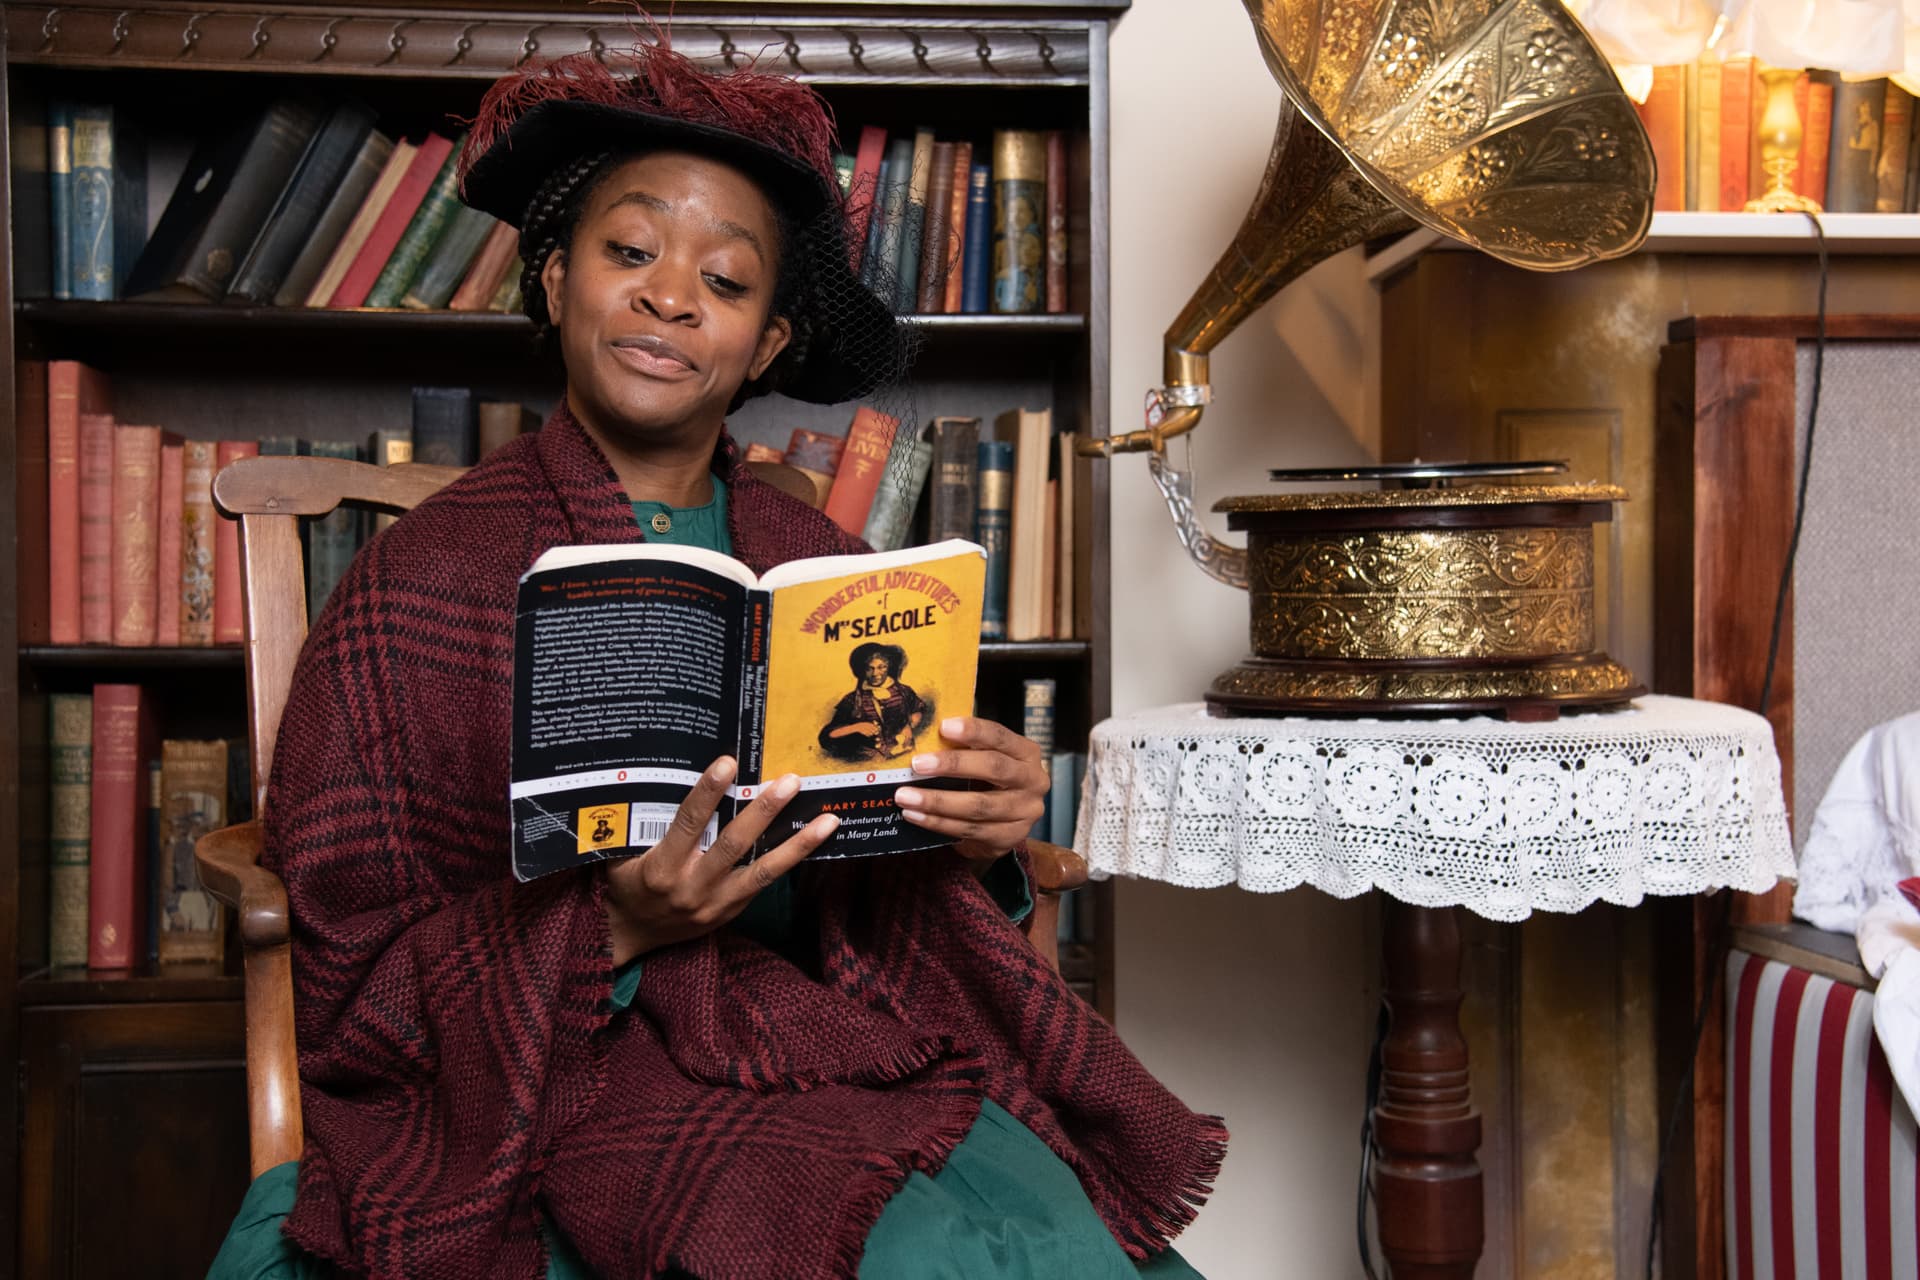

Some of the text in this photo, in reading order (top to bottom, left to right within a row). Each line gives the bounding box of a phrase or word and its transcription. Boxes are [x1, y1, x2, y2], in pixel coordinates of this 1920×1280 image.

[536, 608, 567, 616] Wonderful
[568, 604, 600, 613] Adventures
[799, 571, 961, 634] WONDERFUL ADVENTURES
[604, 618, 627, 626] Crimean
[850, 605, 937, 638] SEACOLE
[751, 602, 763, 662] MARY SEACOLE
[744, 673, 754, 689] Many
[755, 665, 766, 696] Wonderful
[744, 691, 753, 710] Lands
[557, 706, 580, 715] Penguin
[606, 708, 637, 716] Adventures
[752, 696, 763, 730] Adventures
[750, 750, 759, 773] Seacole
[821, 799, 894, 813] MARY SEAC
[884, 812, 898, 826] of
[836, 827, 899, 842] in Many Lands
